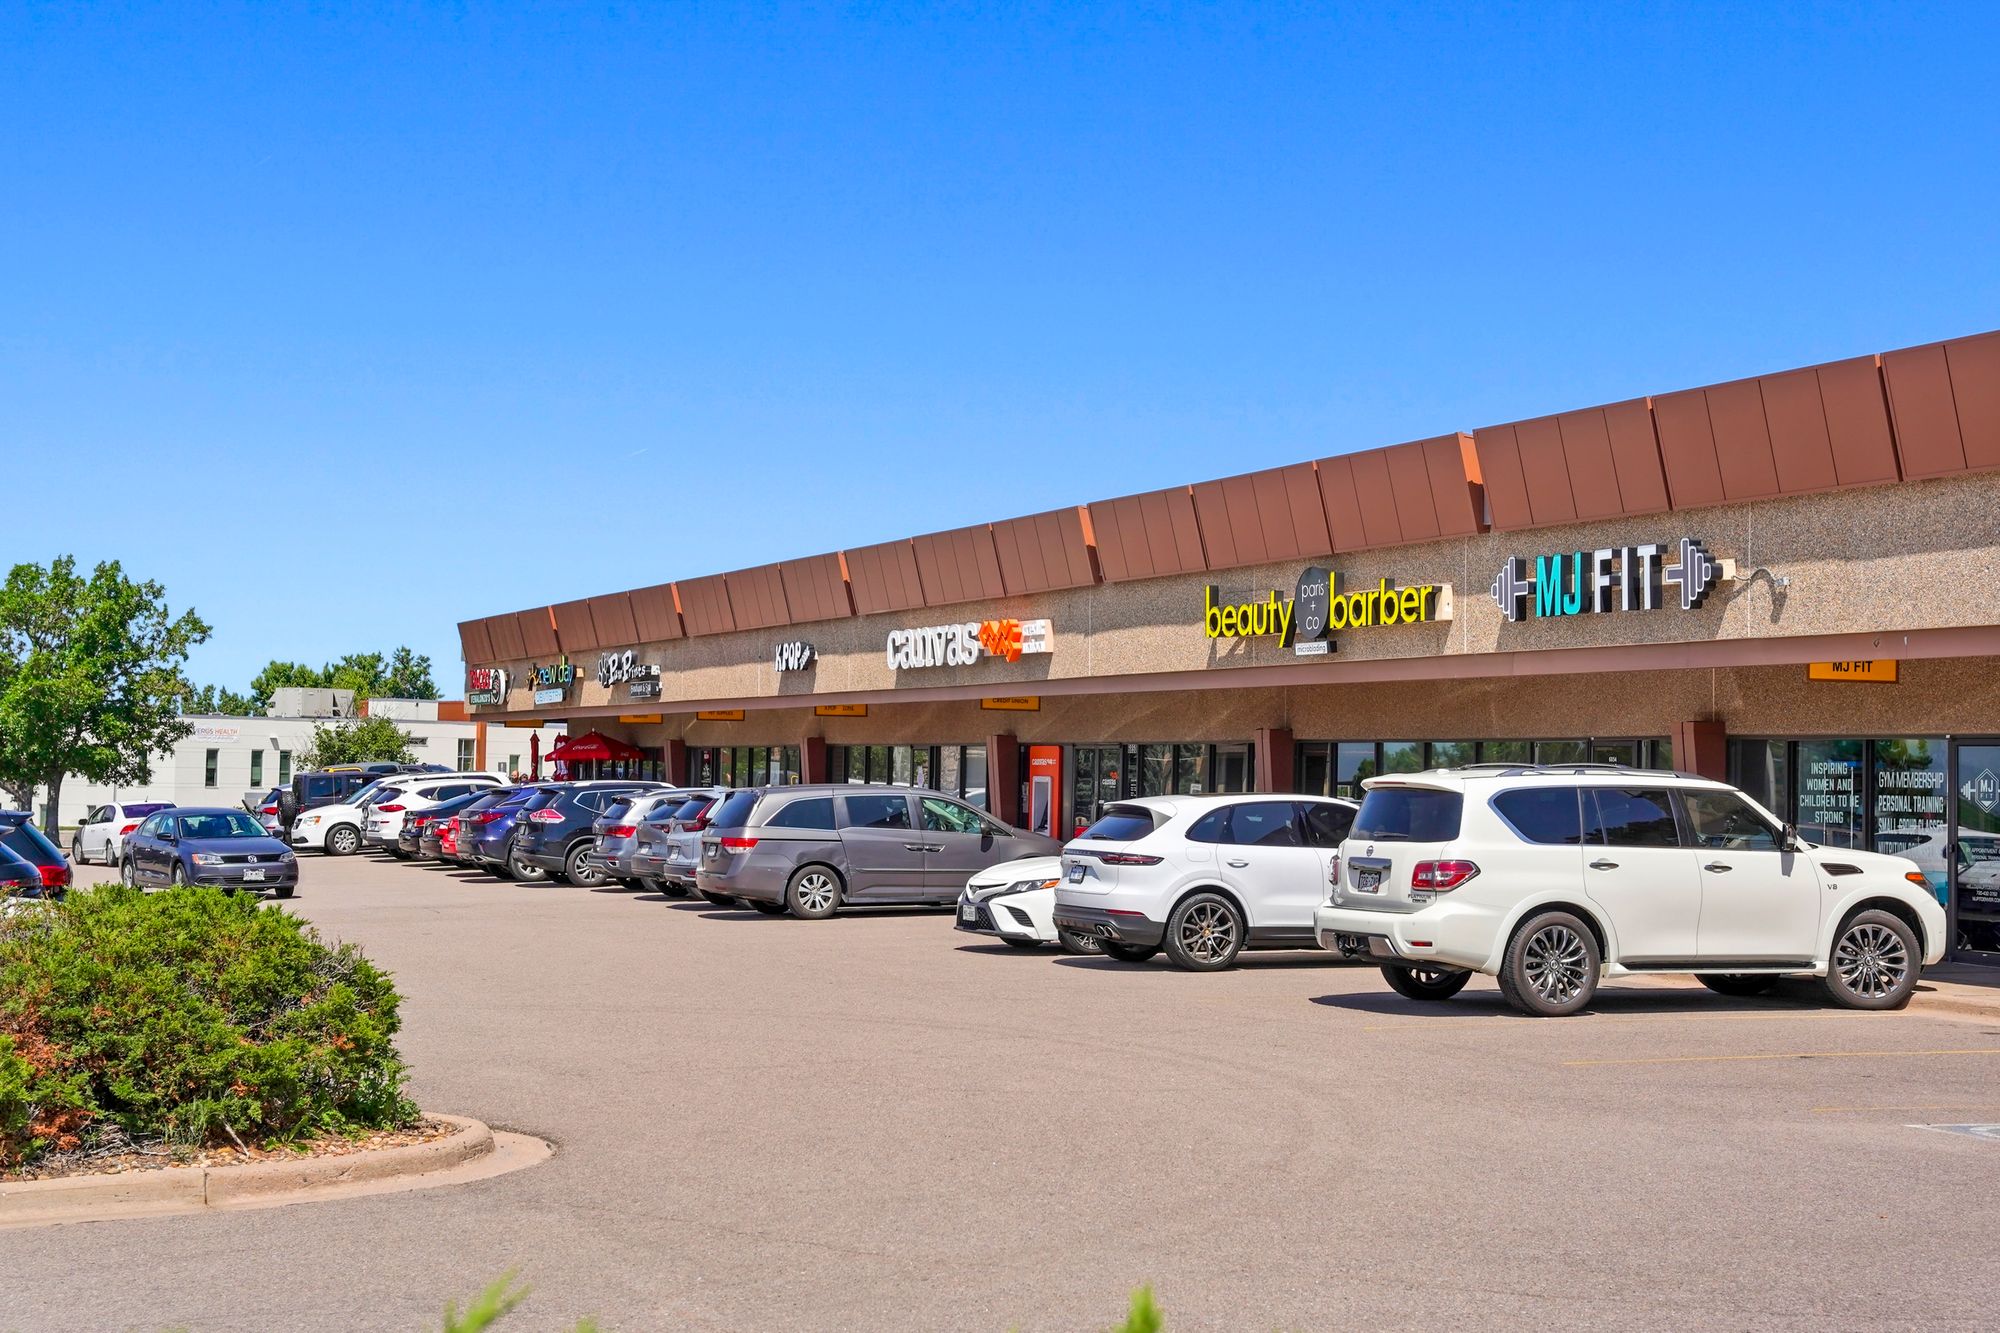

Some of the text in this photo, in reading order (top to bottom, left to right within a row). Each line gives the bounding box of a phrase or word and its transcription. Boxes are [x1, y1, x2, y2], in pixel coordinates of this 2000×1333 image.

[1535, 543, 1658, 617] MJ FIT
[1301, 579, 1325, 603] paris
[1329, 571, 1434, 629] barber
[1205, 584, 1295, 648] beauty
[887, 622, 979, 670] canvas
[775, 641, 802, 672] KPOP
[540, 656, 574, 688] new day
[1832, 660, 1873, 673] MJ FIT
[1811, 762, 1848, 775] INSPIRING
[1806, 778, 1853, 791] WOMEN AND
[1878, 771, 1944, 789] GYM MEMBERSHIP
[1980, 779, 1994, 793] MJ
[1800, 794, 1836, 807] CHILDREN
[1837, 795, 1848, 808] TO
[1878, 795, 1944, 813] PERSONAL TRAINING
[1815, 811, 1844, 824] STRONG
